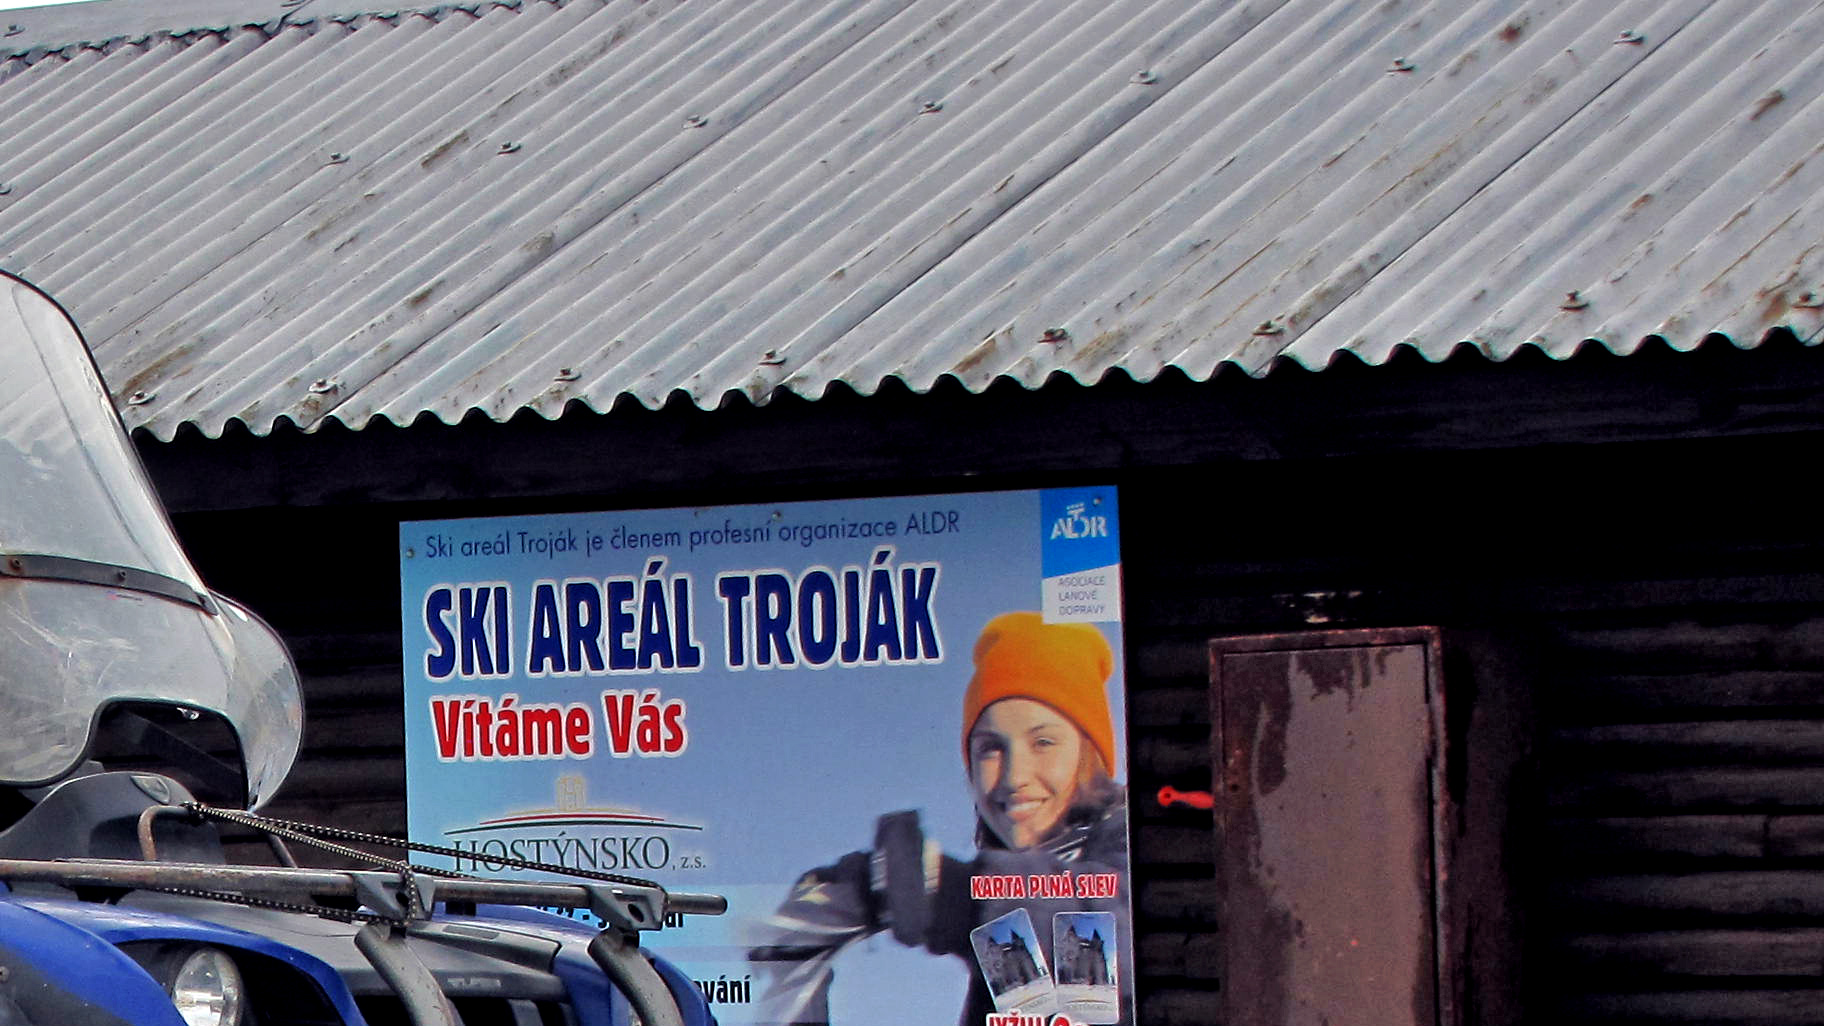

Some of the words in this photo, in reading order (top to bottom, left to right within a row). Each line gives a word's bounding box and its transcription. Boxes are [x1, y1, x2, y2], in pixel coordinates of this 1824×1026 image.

[426, 534, 453, 559] Ski
[461, 530, 510, 557] areál
[517, 528, 577, 560] Troják
[586, 529, 603, 558] je
[610, 525, 681, 550] členem
[690, 519, 771, 552] profesní
[778, 517, 897, 548] organizace
[904, 510, 960, 535] ALDR
[425, 585, 510, 679] SKI
[528, 560, 701, 674] AREÁL
[718, 549, 940, 666] TROJÁK
[431, 697, 591, 758] Vítáme
[603, 693, 685, 754] Vás
[971, 875, 1026, 899] KARTA
[1029, 870, 1074, 899] PLNÁ
[1078, 873, 1118, 898] SLEV
